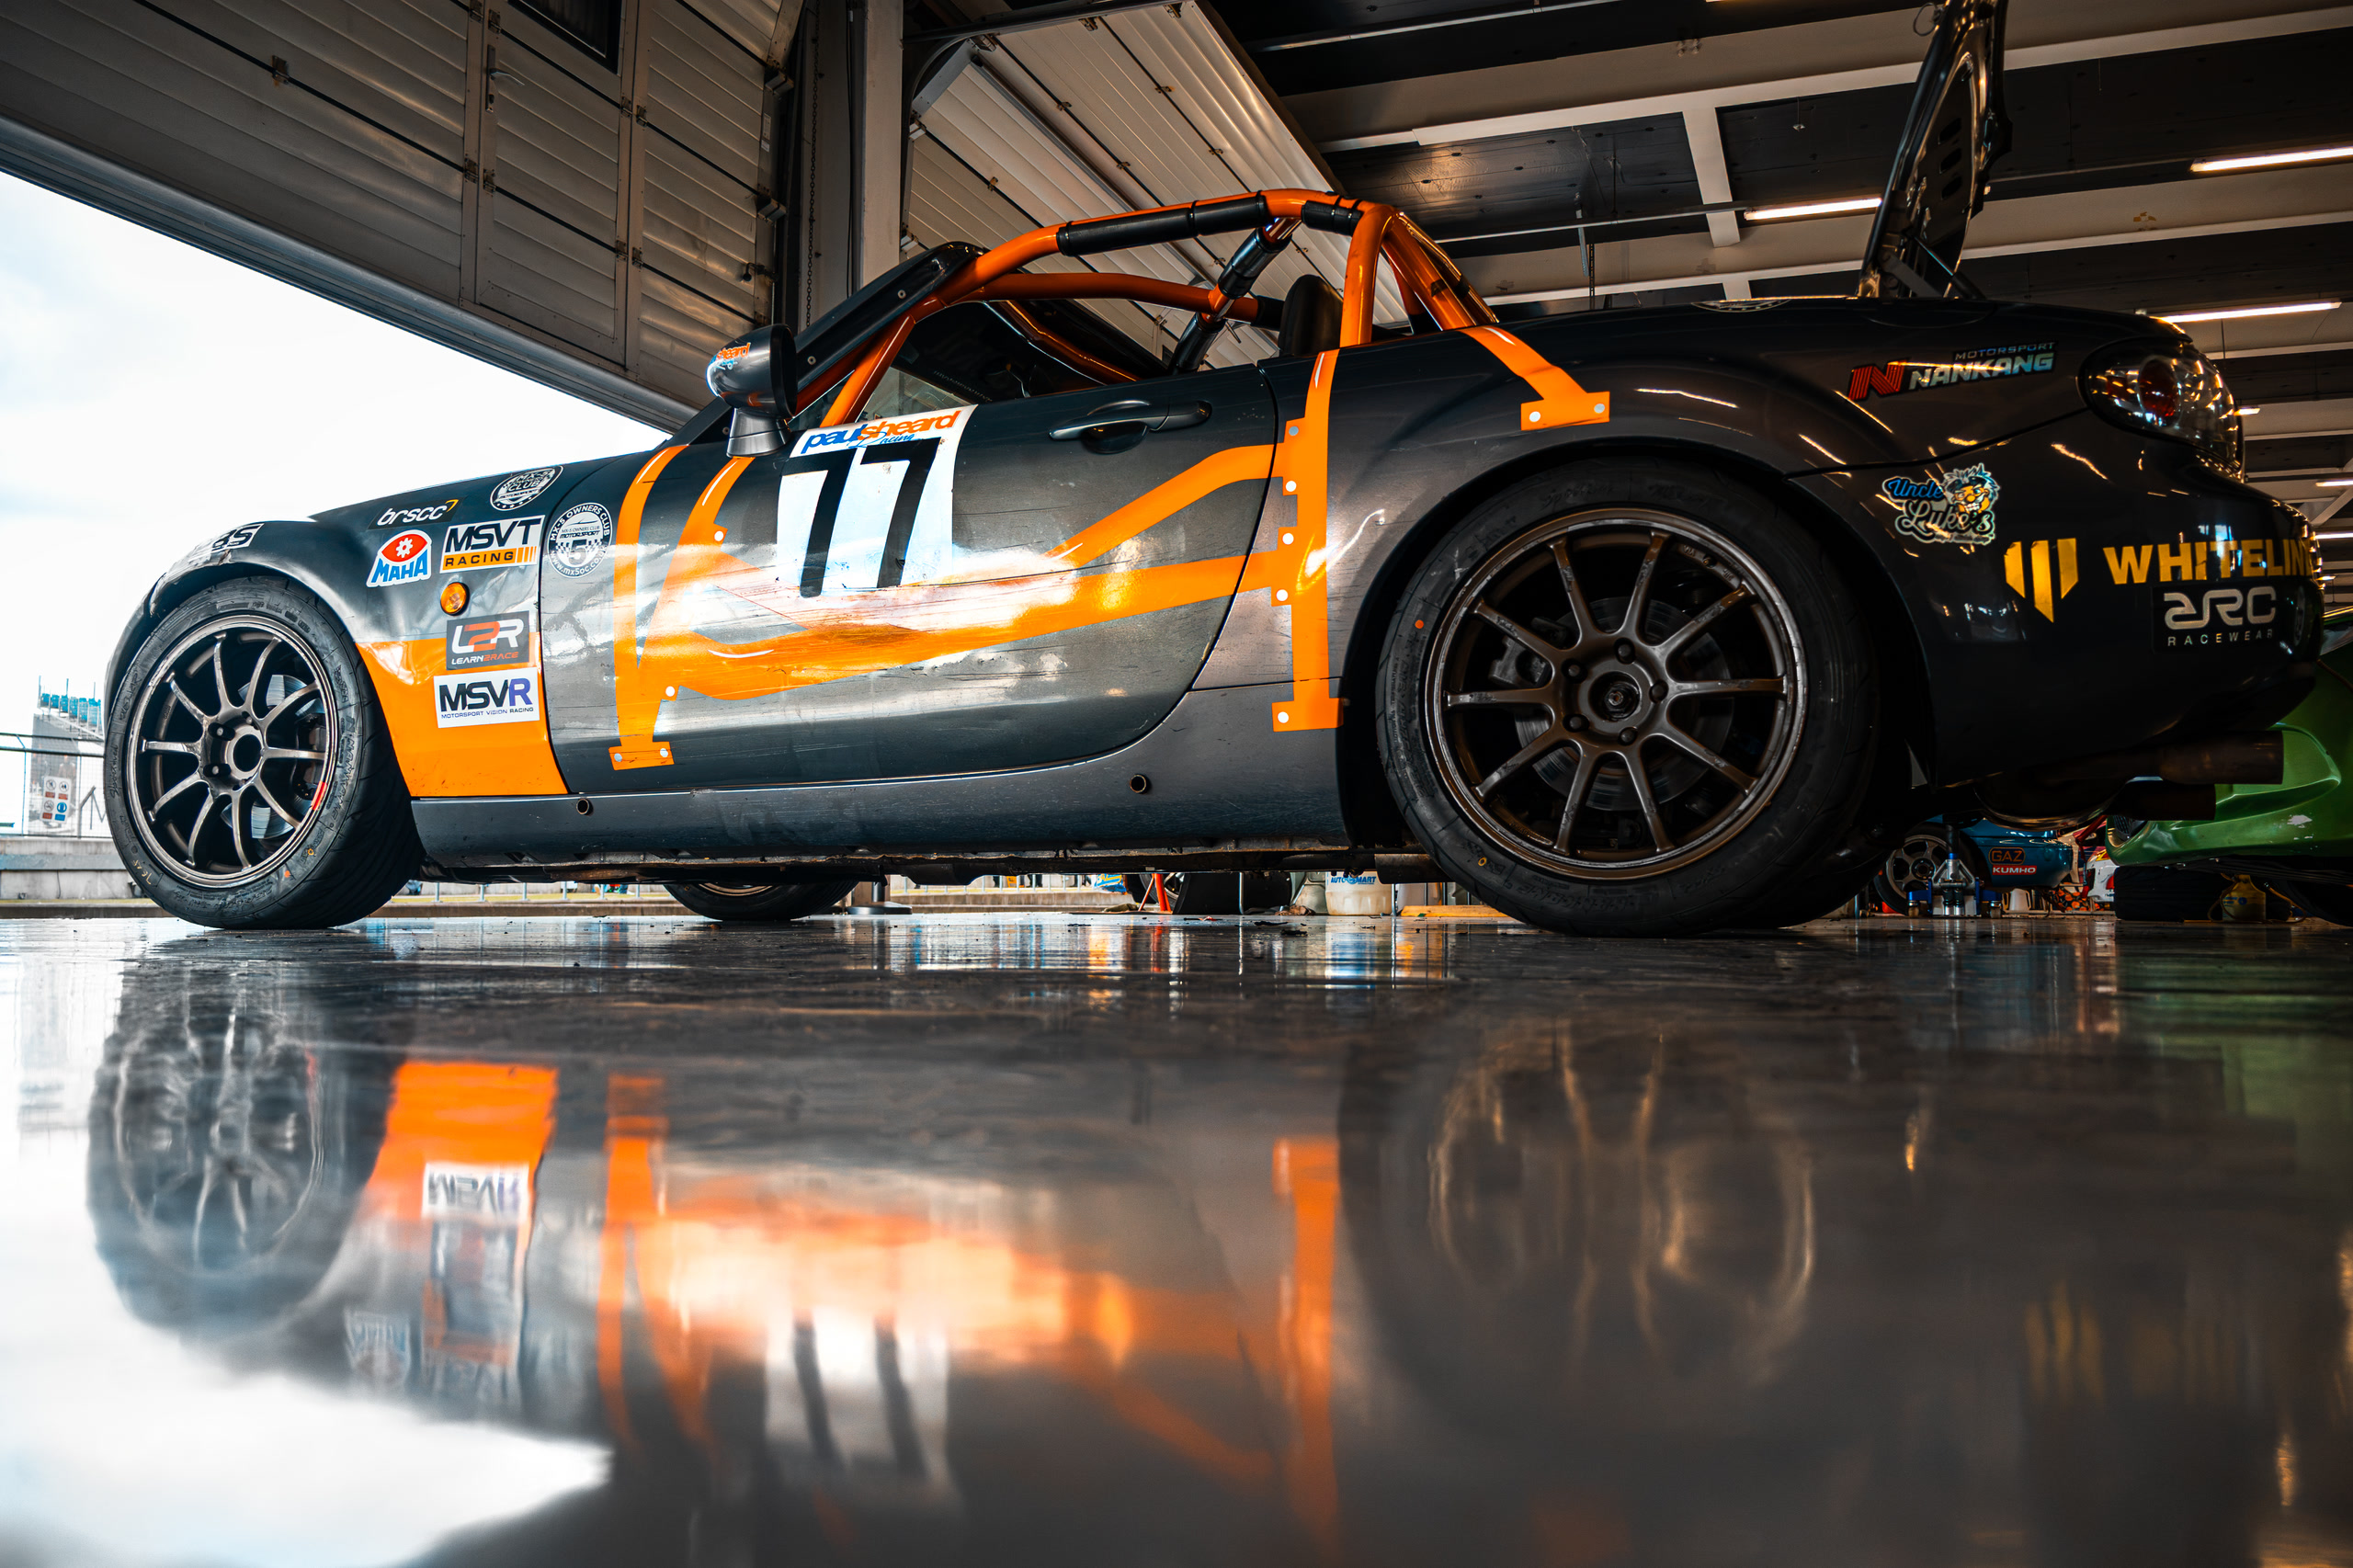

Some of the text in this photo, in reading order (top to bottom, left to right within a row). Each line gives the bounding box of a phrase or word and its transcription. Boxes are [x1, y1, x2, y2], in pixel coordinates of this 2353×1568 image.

[1955, 341, 2056, 361] MOTORSPORT
[1909, 353, 2054, 391] NANKANG
[508, 480, 540, 492] CLUB
[1888, 479, 1943, 498] Uncle
[377, 505, 448, 526] brscc
[550, 505, 610, 541] MX-5 OWNERS CLUB
[780, 437, 942, 598] 77
[1902, 501, 1991, 538] Luke's
[445, 518, 541, 553] MSVT
[371, 549, 428, 584] MAHA
[446, 551, 514, 567] RACING
[451, 619, 524, 653] L2R
[2167, 629, 2273, 647] RACEWEAR
[451, 652, 519, 665] LEARN2RACE
[438, 678, 533, 712] MSVR
[1992, 850, 2022, 862] GAZ
